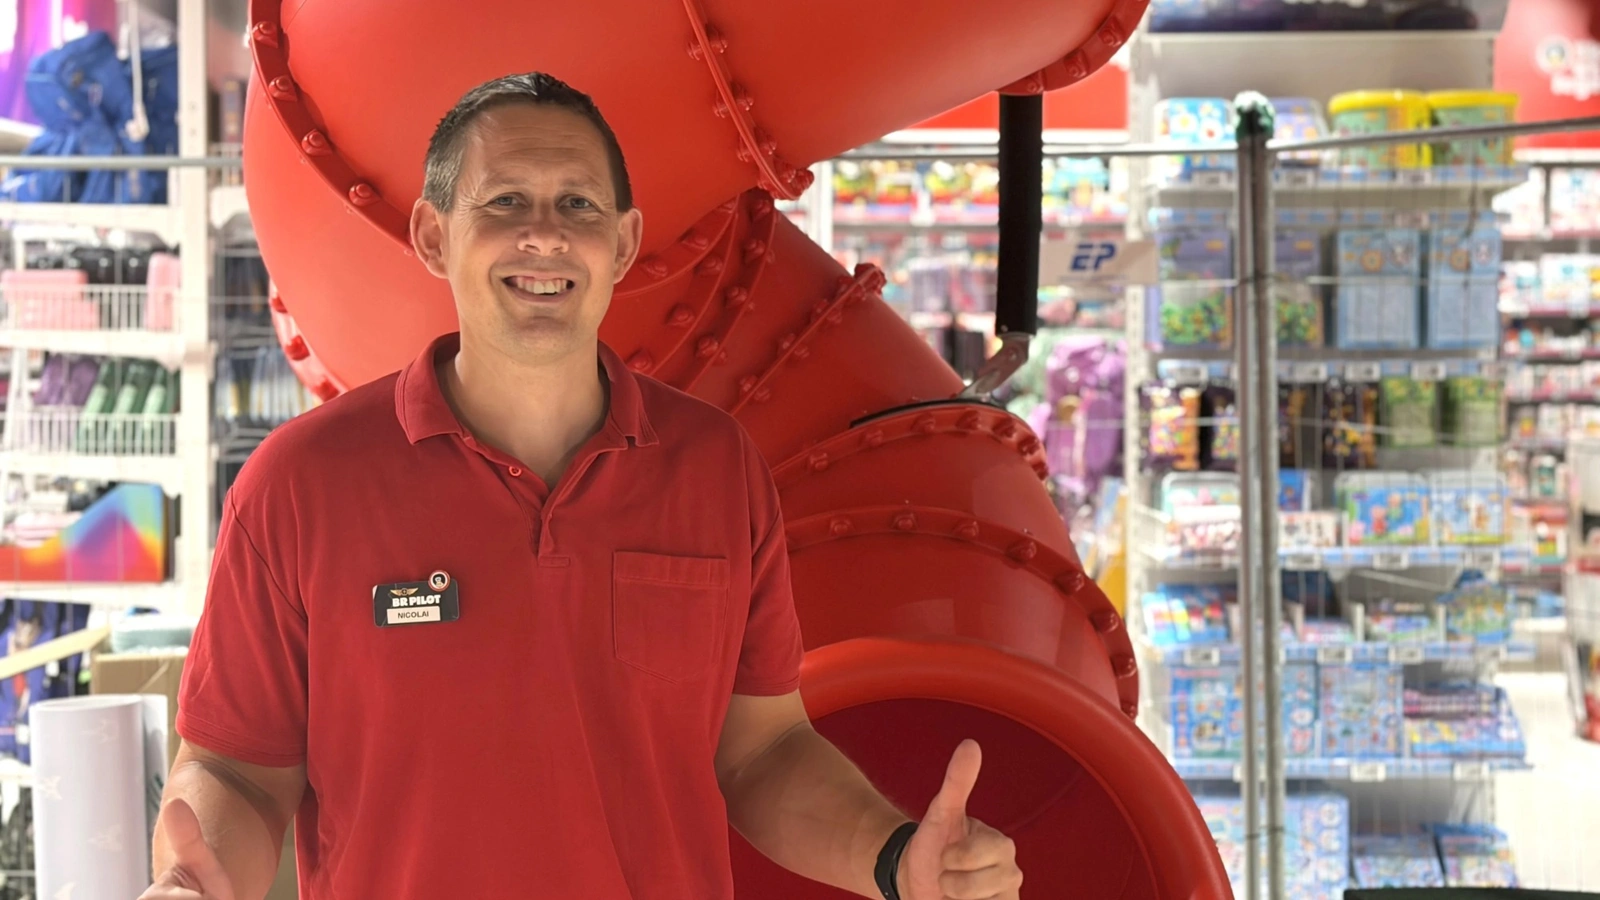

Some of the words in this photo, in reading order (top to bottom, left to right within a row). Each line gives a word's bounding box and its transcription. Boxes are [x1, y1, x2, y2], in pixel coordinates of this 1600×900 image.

[1071, 243, 1116, 271] EP
[392, 597, 408, 607] BR
[409, 595, 441, 606] PILOT
[397, 611, 429, 619] NICOLAI
